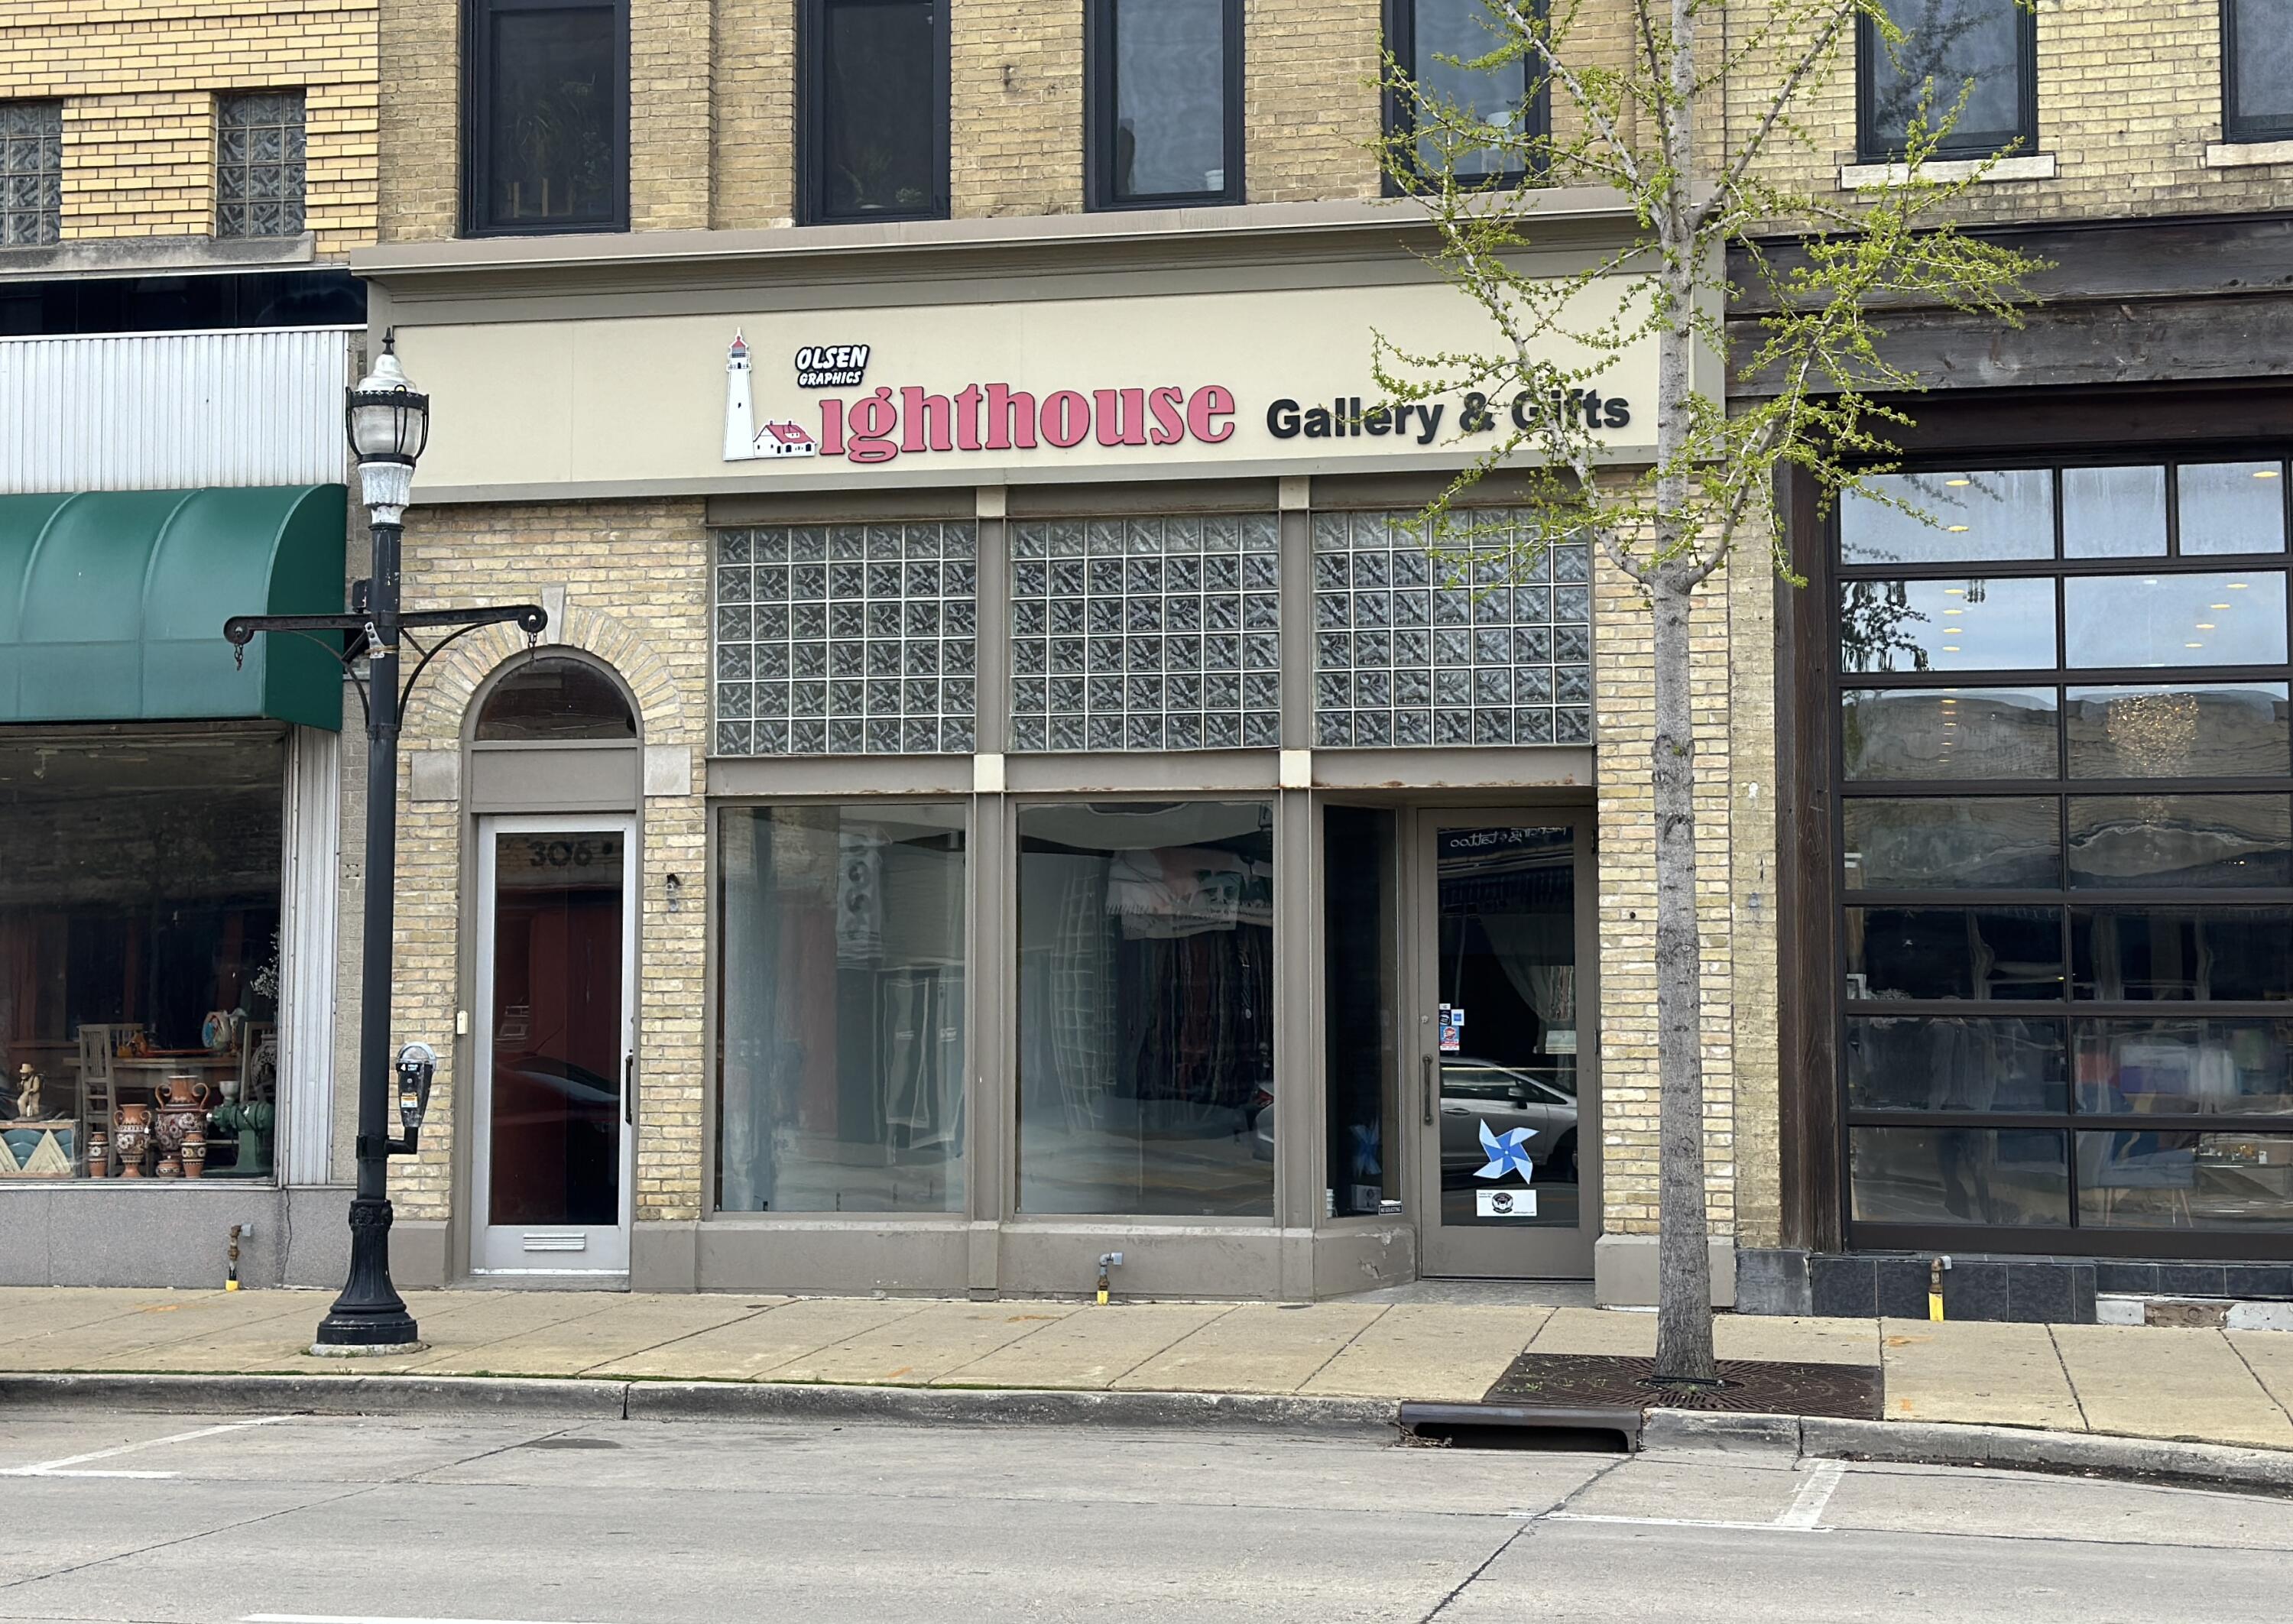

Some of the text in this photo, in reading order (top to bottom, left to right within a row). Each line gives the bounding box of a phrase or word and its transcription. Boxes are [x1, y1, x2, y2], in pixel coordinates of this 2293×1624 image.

[796, 345, 869, 370] OLSEN
[798, 370, 862, 387] GRAPHICS
[1266, 397, 1445, 445] Gallery
[1458, 391, 1496, 432] &
[1511, 387, 1631, 430] Gifts
[527, 839, 594, 867] 306
